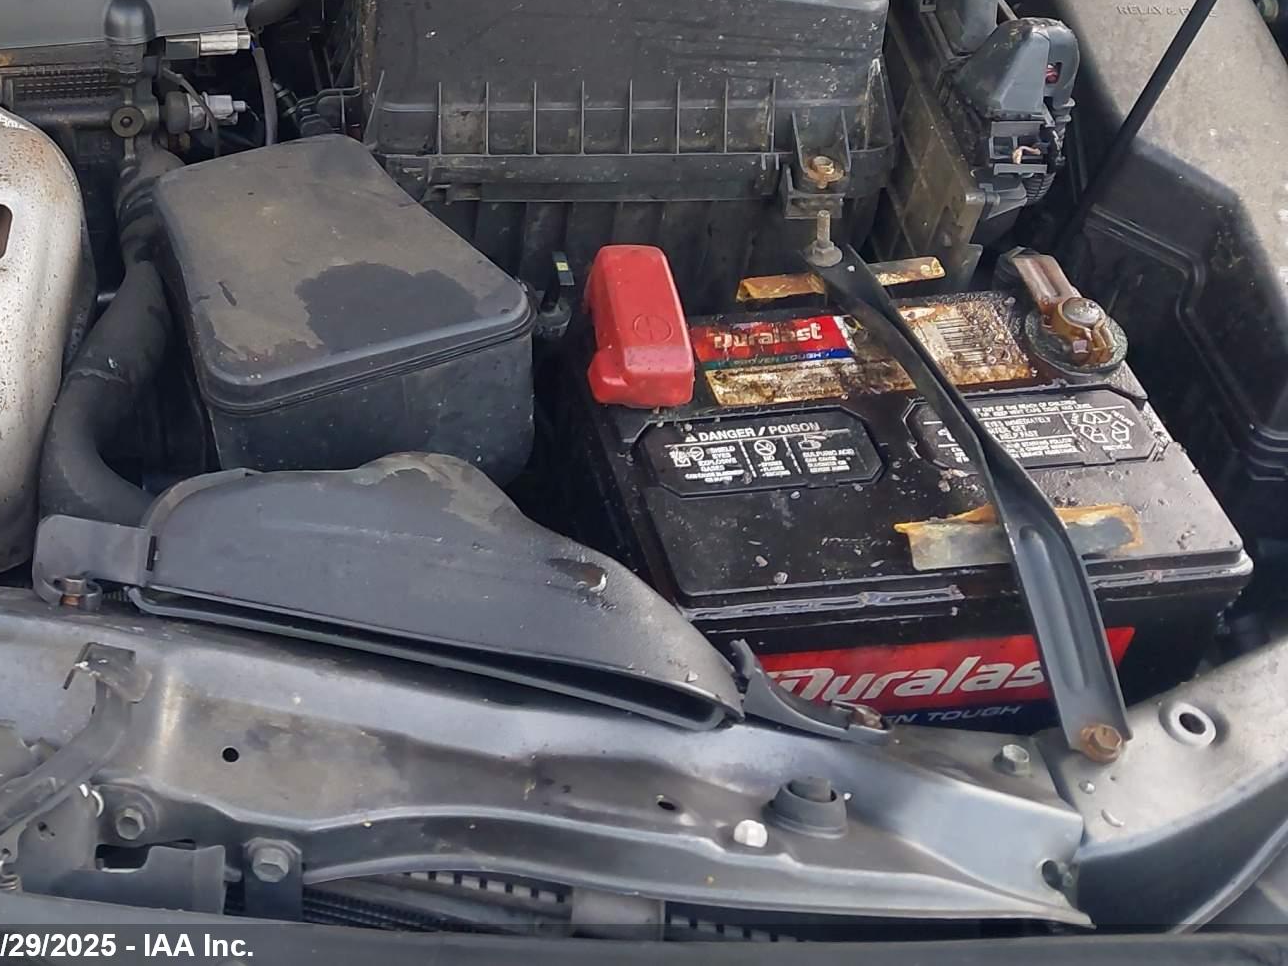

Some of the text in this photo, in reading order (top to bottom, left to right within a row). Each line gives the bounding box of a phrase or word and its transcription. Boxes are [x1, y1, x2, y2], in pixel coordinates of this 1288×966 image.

[1116, 4, 1162, 17] RELAY
[698, 427, 756, 443] DANGER
[768, 422, 820, 436] POISON
[766, 655, 1046, 702] Duralas
[928, 705, 1021, 721] TOUGH
